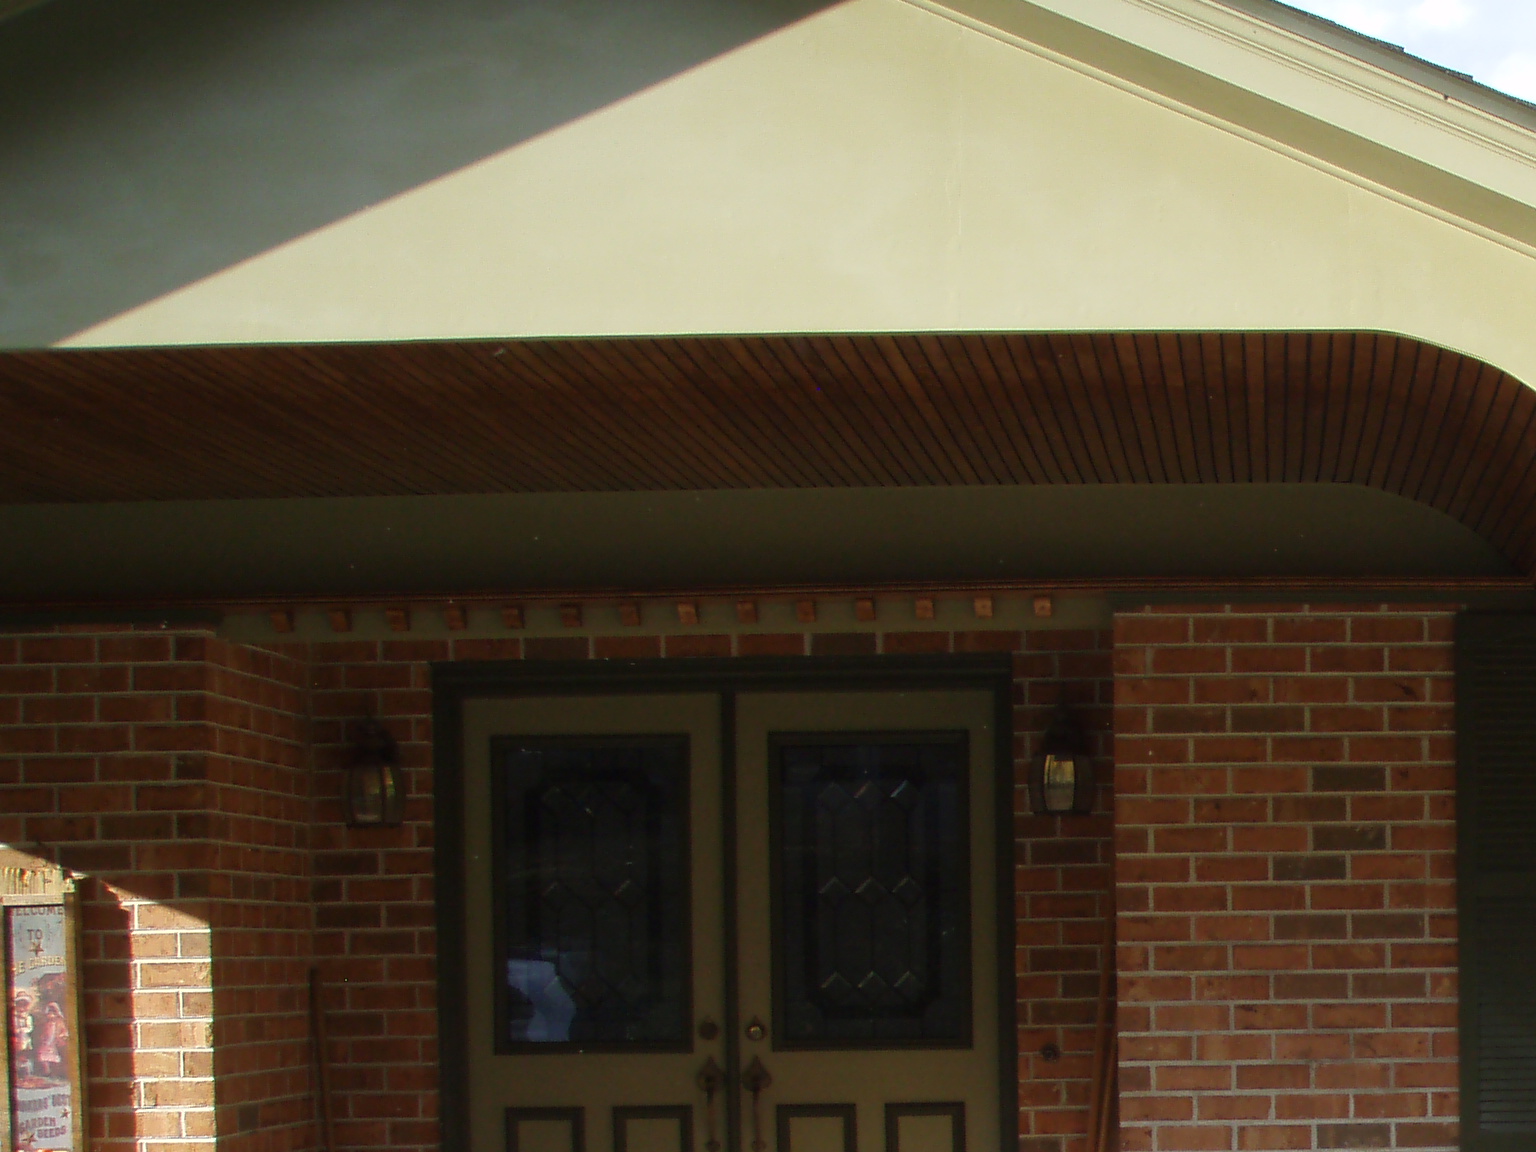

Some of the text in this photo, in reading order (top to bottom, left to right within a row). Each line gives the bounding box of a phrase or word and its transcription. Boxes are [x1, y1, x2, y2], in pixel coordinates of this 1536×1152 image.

[27, 928, 43, 941] TO
[19, 1116, 56, 1135] GARDEN
[37, 1126, 67, 1138] SEEDS
